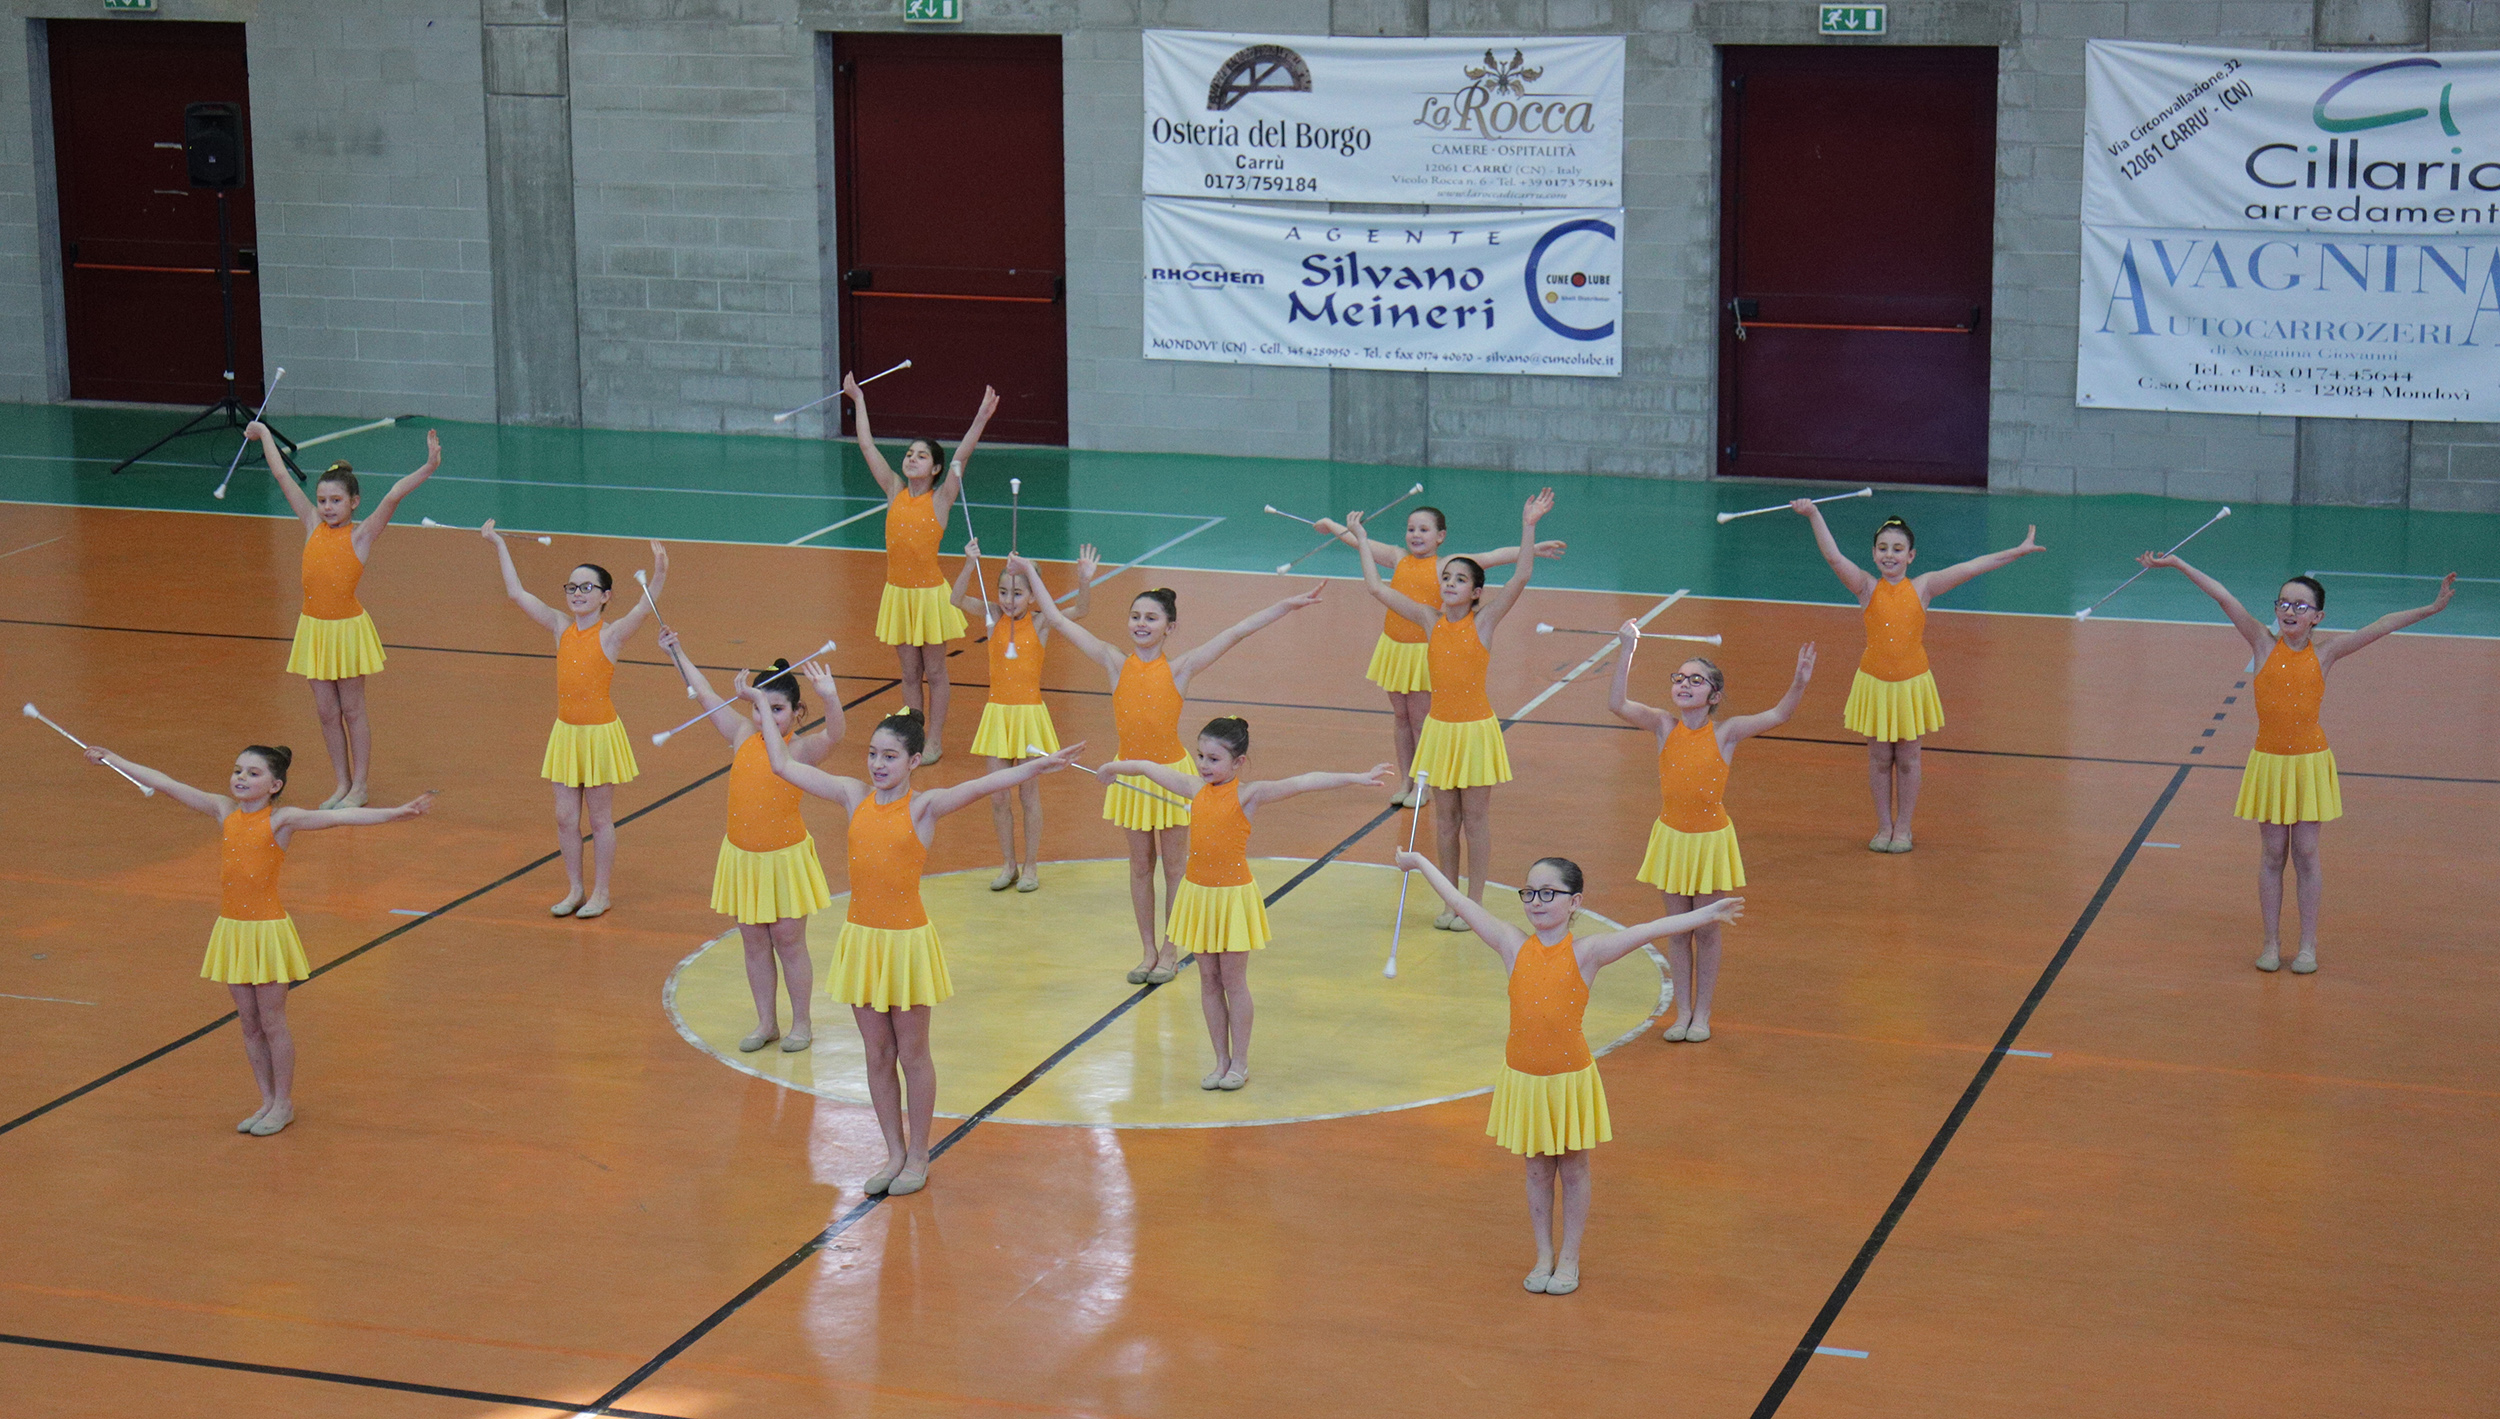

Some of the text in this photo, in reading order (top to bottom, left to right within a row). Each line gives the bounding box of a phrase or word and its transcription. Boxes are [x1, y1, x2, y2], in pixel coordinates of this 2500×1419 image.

[1413, 80, 1595, 140] La Rocca
[1152, 117, 1371, 157] Osteria del Borgo
[2120, 142, 2164, 181] 12061
[2218, 79, 2253, 111] (CN)
[1432, 143, 1576, 157] CAMERE OSPITALITÀ
[2108, 139, 2130, 157] Via
[1235, 154, 1284, 170] Carrù
[1425, 164, 1458, 173] 12061
[1515, 165, 1546, 176] (CN)
[1557, 166, 1582, 178] Italy
[1204, 173, 1318, 192] 0173/759184
[1392, 174, 1428, 185] Vicolo
[1431, 176, 1464, 186] Rocca
[1479, 178, 1487, 186] 6
[1499, 177, 1516, 187] Tel.
[1519, 179, 1542, 187] +39
[1545, 178, 1576, 188] 0173
[1578, 178, 1614, 188] 75194
[1301, 251, 1484, 292] Silvano
[1288, 290, 1495, 330] Meineri
[1221, 341, 1247, 355] (CN)
[1260, 342, 1283, 355] Cell.
[1363, 347, 1382, 359] Tel.
[1395, 348, 1414, 360] fax
[2210, 345, 2226, 355] di
[2318, 348, 2398, 361] Giovanni
[2189, 362, 2413, 382] Tel. e Fax 0174.45644
[2138, 376, 2179, 390] C.so
[2274, 382, 2286, 394] 3
[2313, 384, 2374, 397] 12084
[2382, 385, 2470, 401] Mondovì
